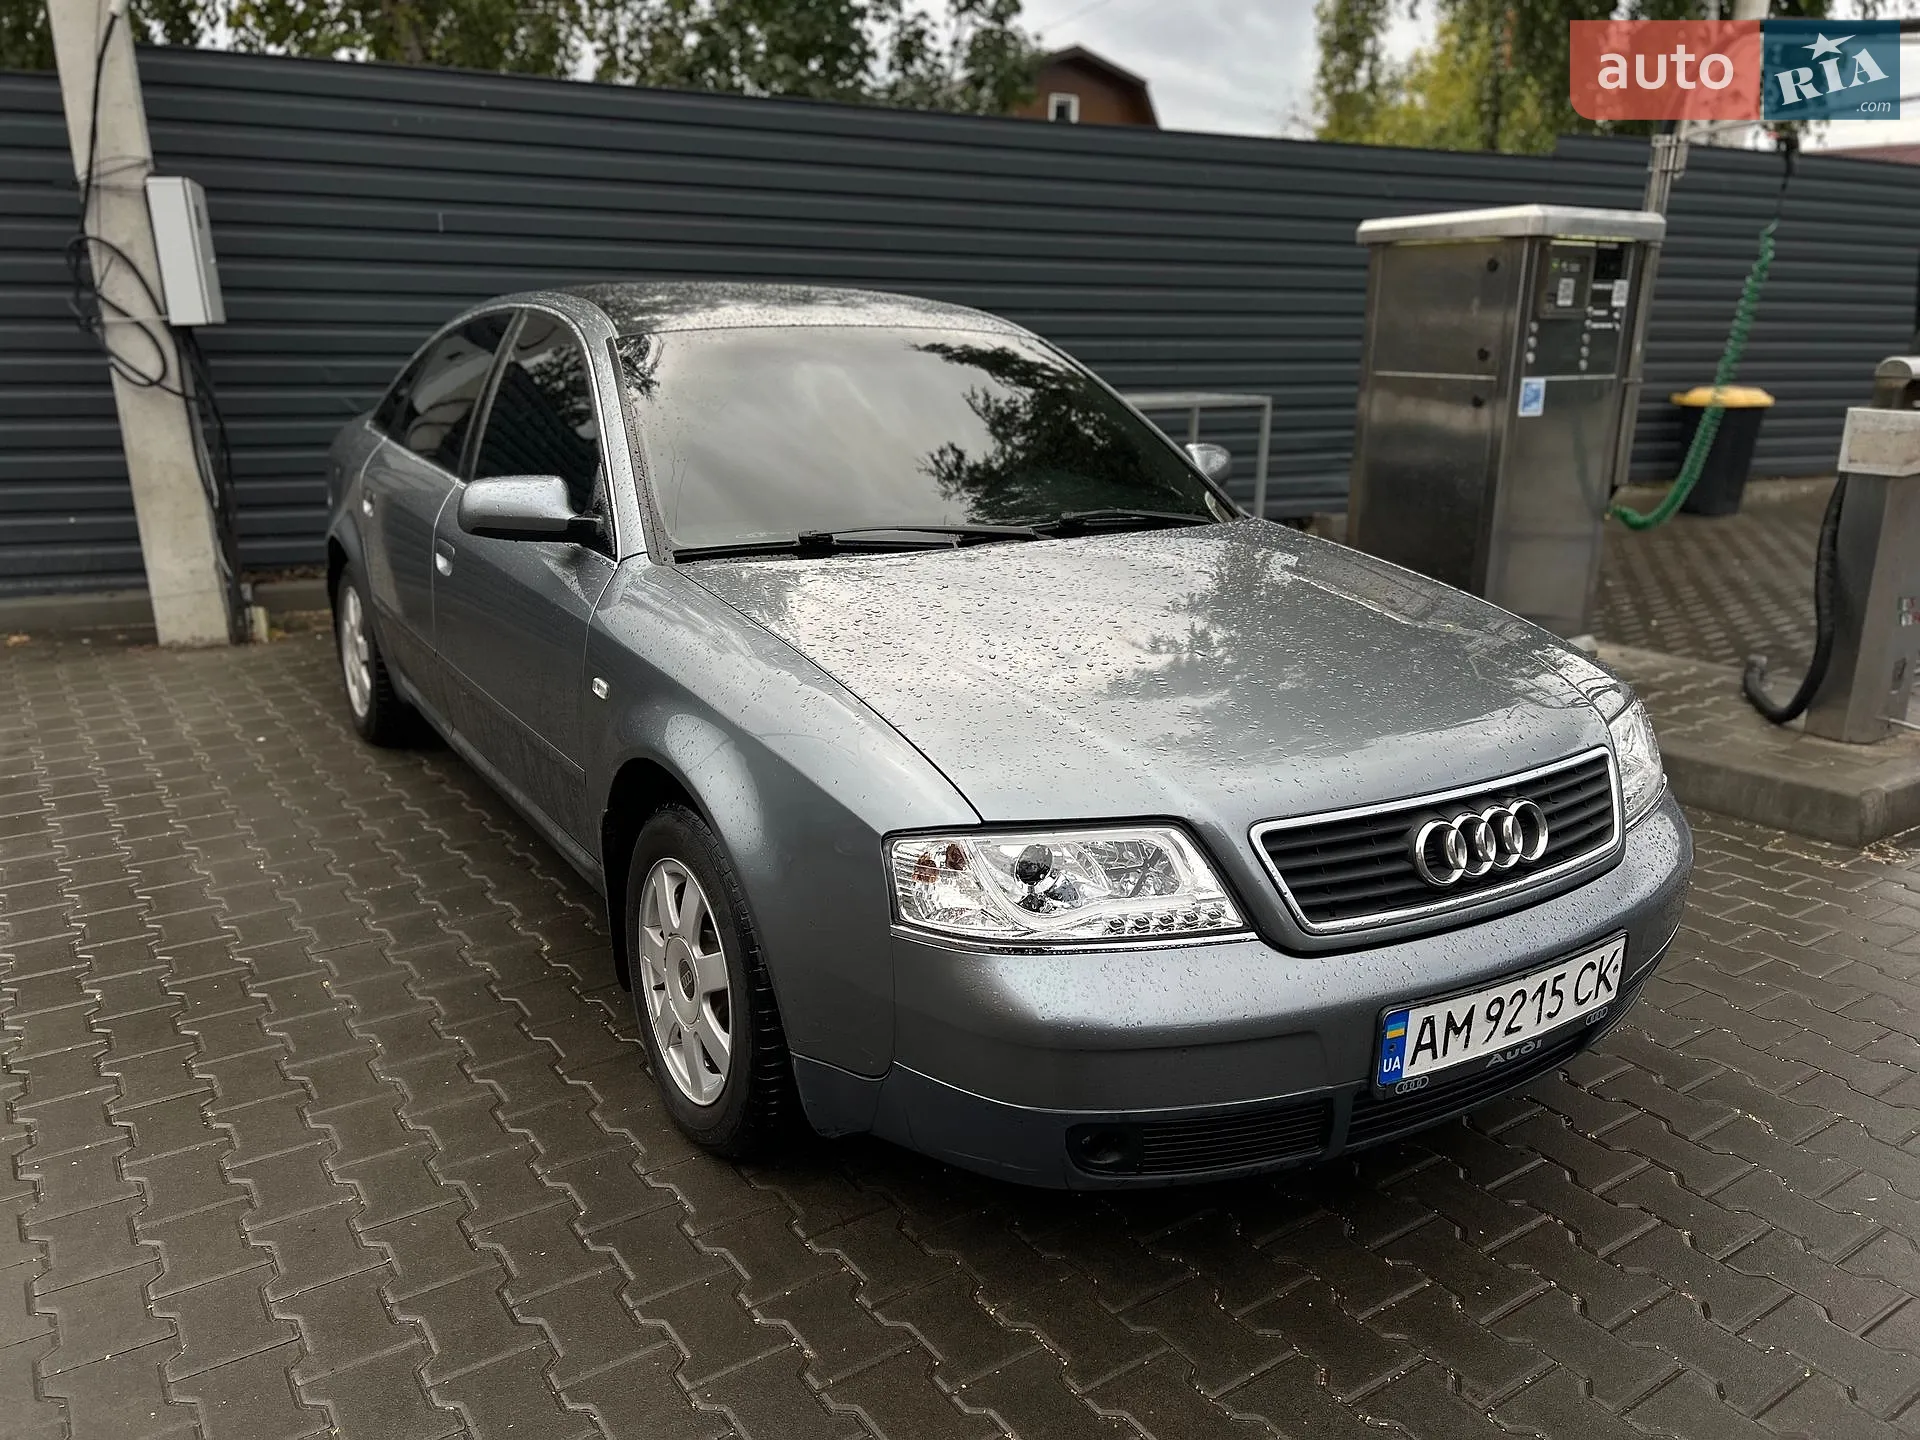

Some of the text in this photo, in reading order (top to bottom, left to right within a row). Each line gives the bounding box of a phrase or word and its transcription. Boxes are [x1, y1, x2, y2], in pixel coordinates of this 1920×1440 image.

[1408, 947, 1621, 1067] AM 9215 CK
[1383, 1056, 1401, 1073] UA
